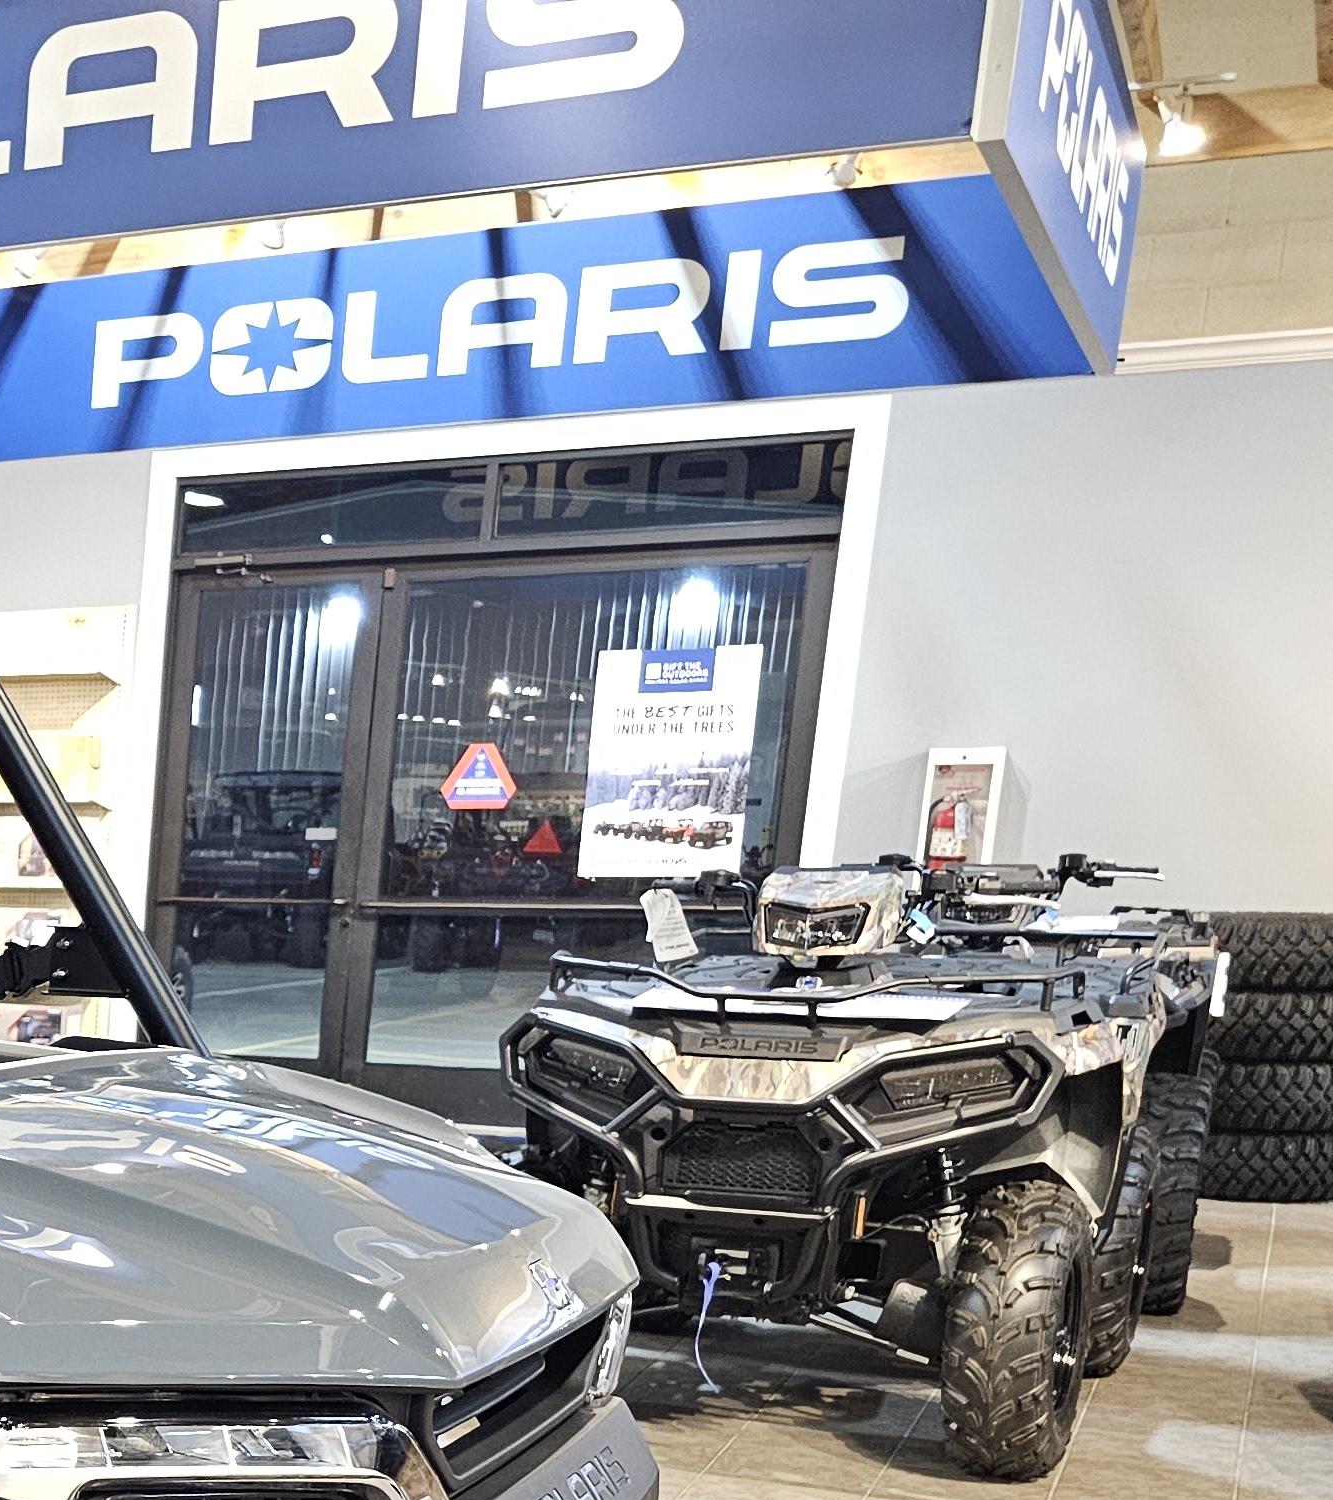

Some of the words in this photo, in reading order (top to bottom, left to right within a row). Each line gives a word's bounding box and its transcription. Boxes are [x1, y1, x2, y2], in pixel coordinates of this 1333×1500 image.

[1039, 0, 1129, 287] POLARIS
[91, 236, 910, 409] POLARIS
[644, 705, 694, 718] BEST
[663, 722, 684, 734] THE
[694, 721, 734, 733] TREES
[700, 1036, 819, 1055] POLARIS
